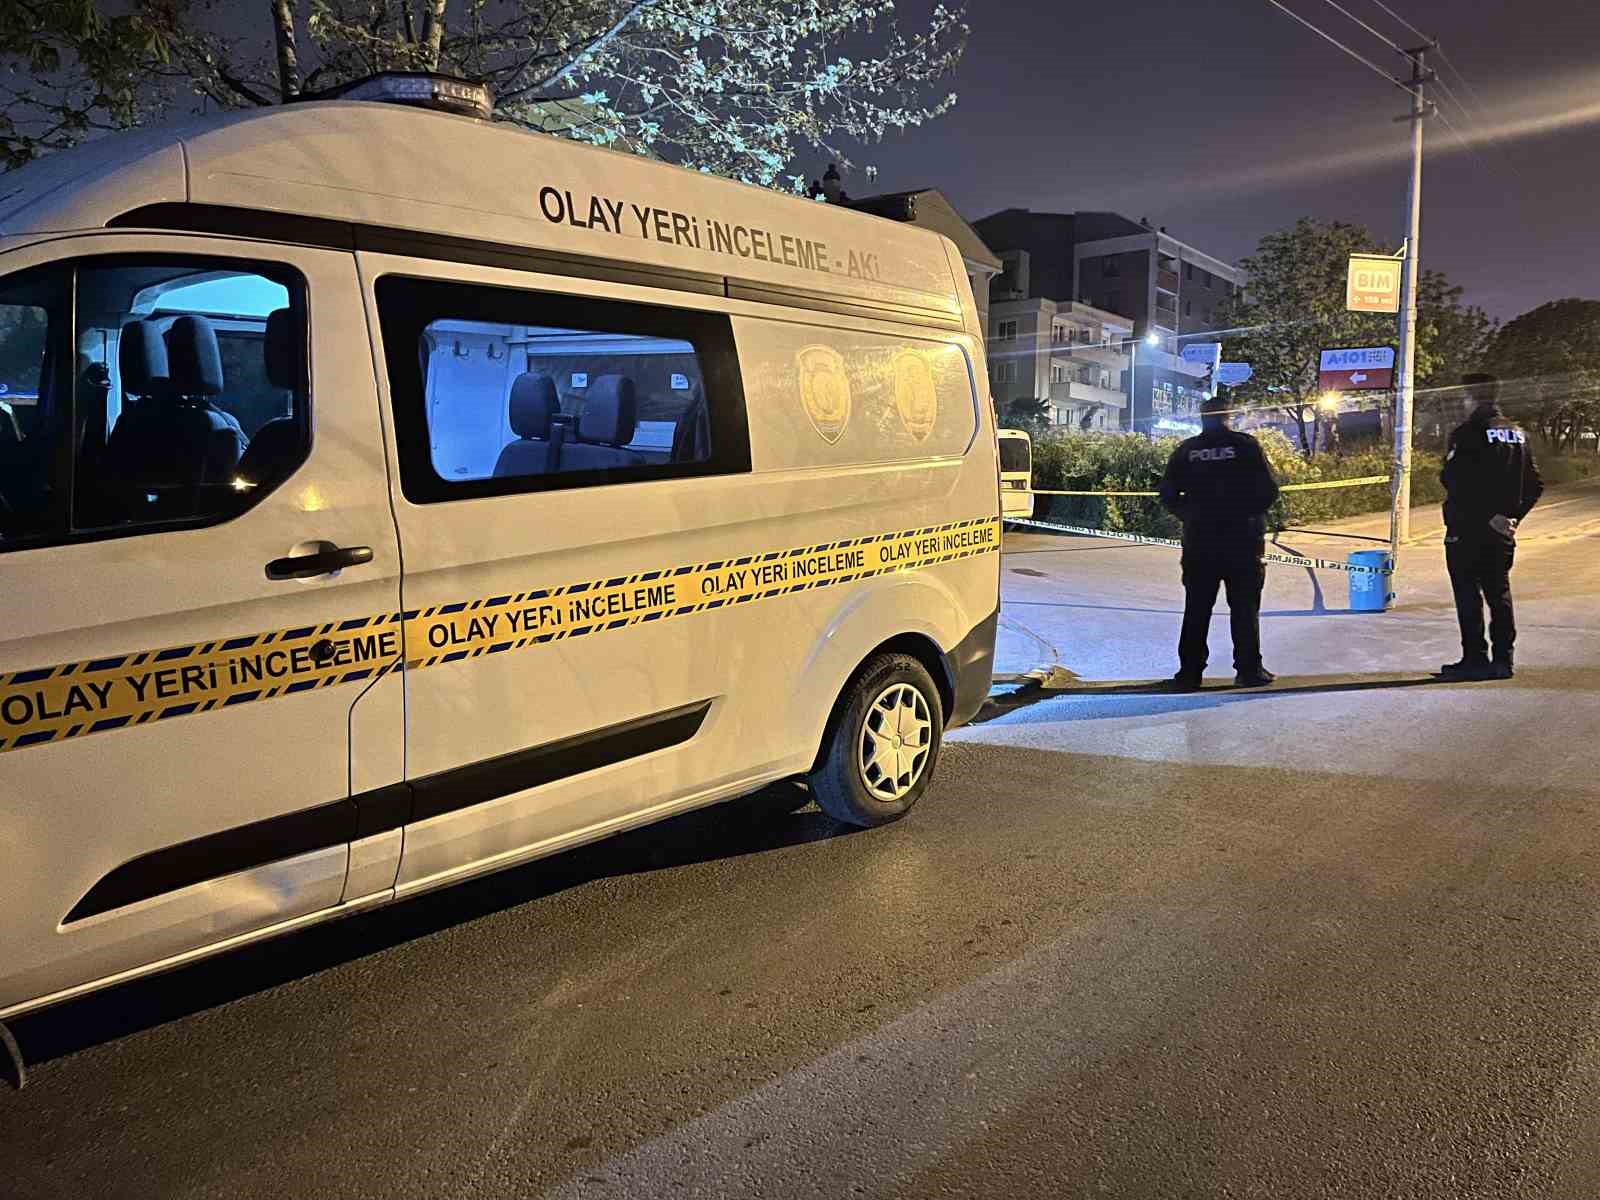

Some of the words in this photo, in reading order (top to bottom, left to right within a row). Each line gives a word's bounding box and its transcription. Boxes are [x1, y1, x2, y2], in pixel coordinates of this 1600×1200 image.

[539, 186, 624, 234] OLAY
[879, 543, 912, 562] OLAY
[701, 571, 746, 596] OLAY
[428, 614, 499, 648] OLAY
[1, 681, 114, 726] OLAY
